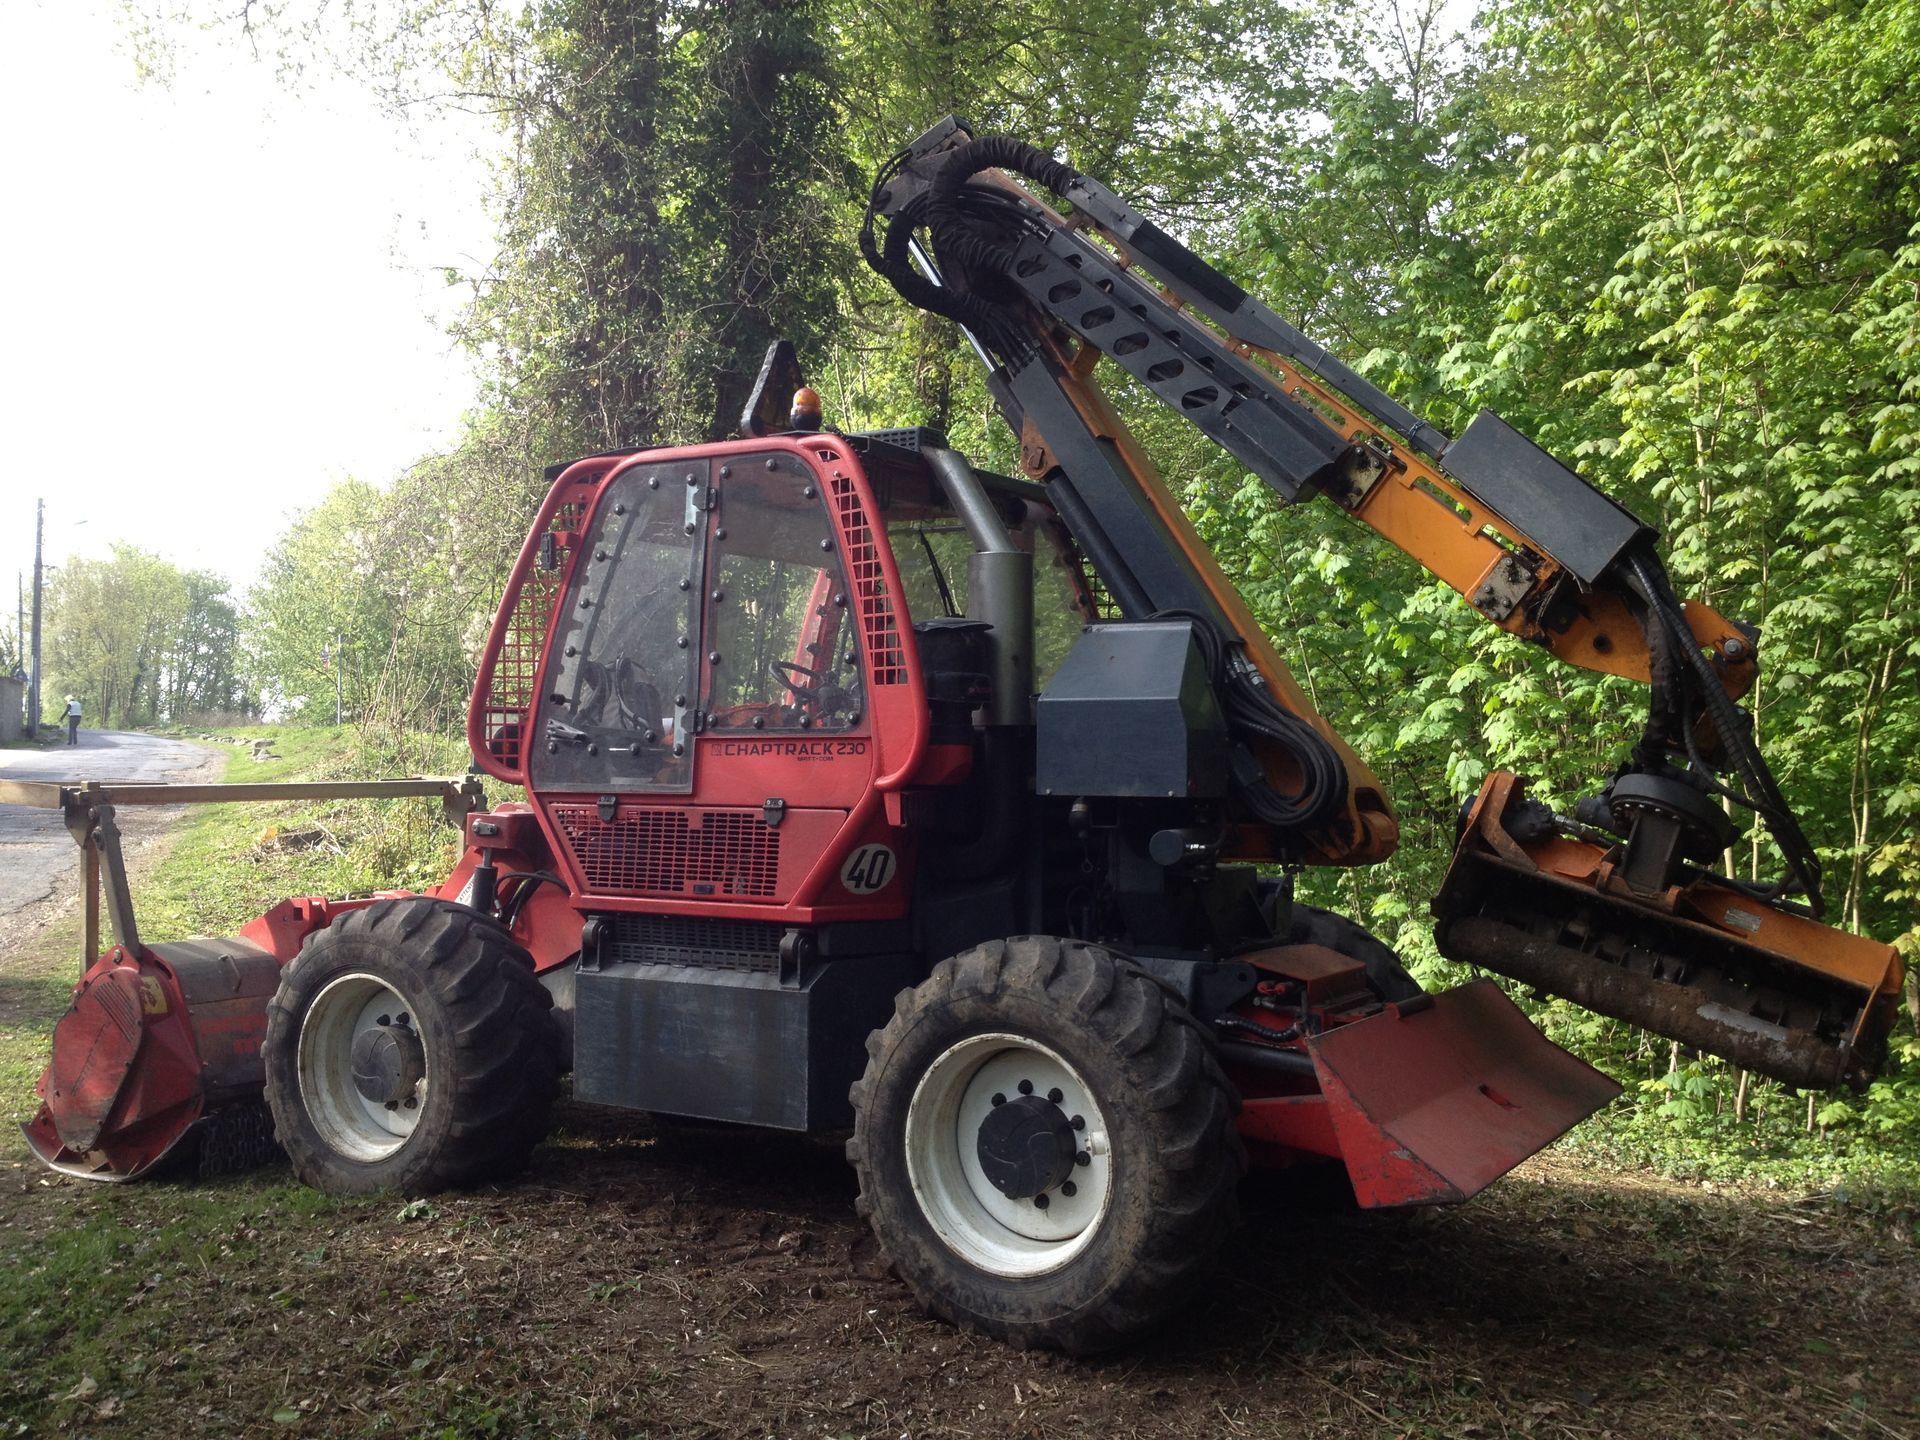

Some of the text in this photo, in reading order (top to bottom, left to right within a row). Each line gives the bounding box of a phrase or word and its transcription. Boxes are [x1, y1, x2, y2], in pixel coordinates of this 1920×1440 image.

[725, 742, 866, 756] CHAPTRACK 230
[846, 849, 890, 889] 40
[459, 880, 474, 902] ATTENT
